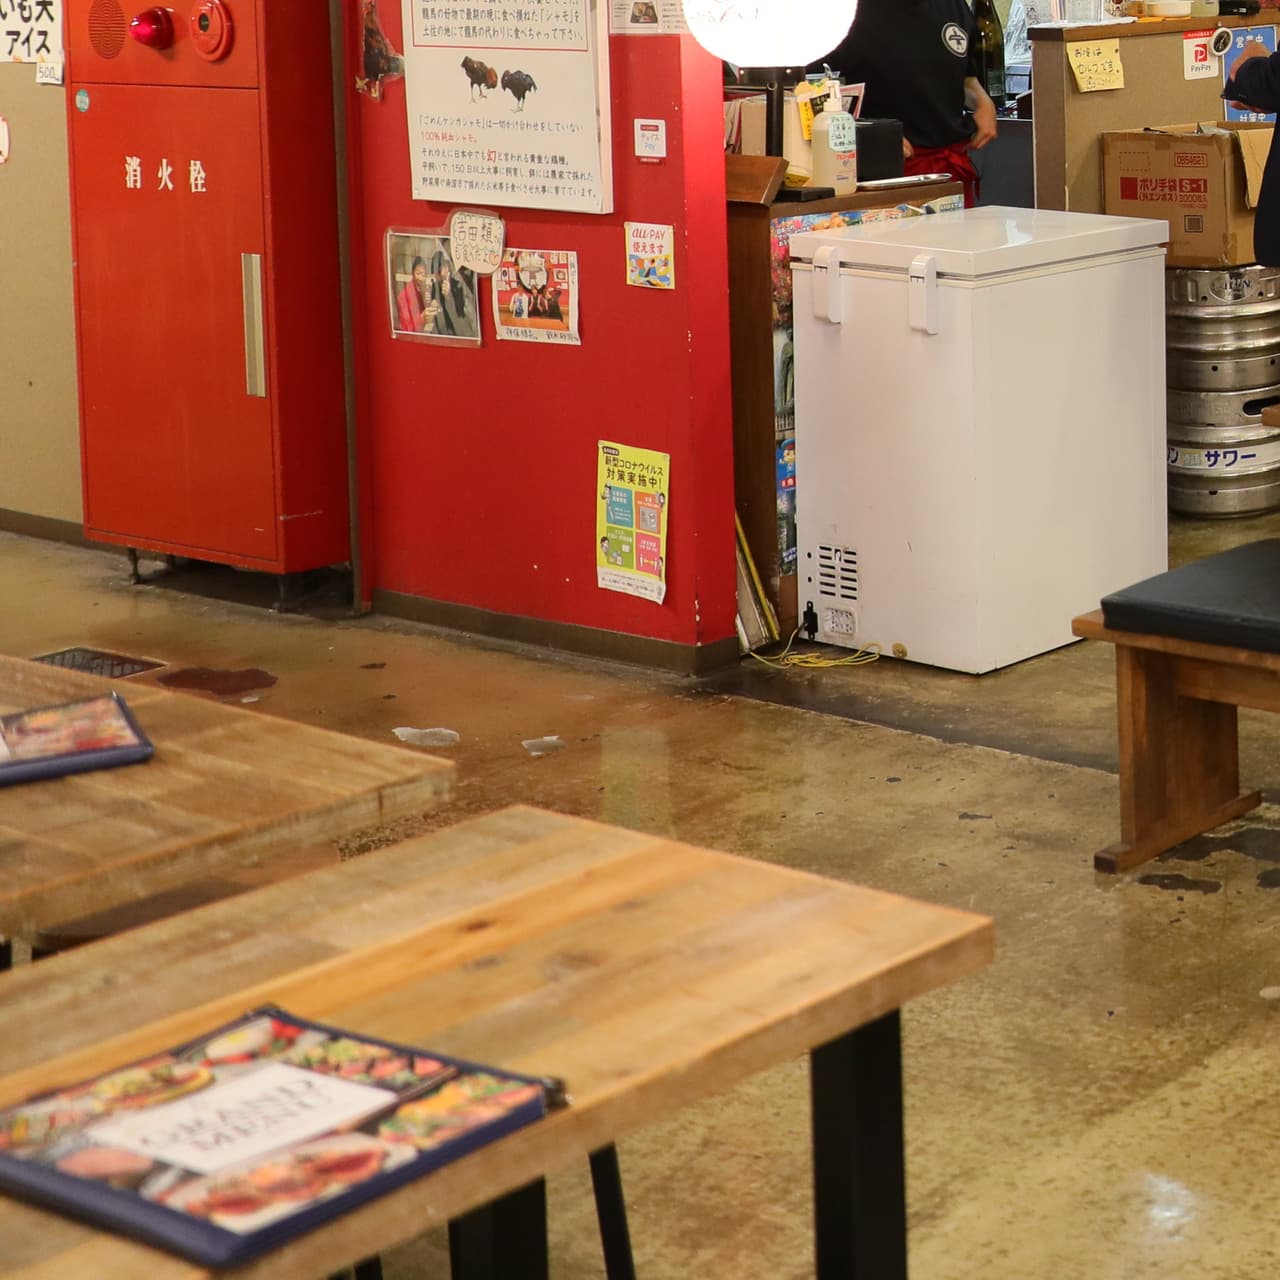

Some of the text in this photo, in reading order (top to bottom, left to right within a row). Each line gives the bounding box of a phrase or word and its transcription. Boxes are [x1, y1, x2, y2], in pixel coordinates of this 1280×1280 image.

[6, 28, 51, 58] アイス
[1191, 64, 1211, 72] PayPay
[125, 156, 207, 193] 消火栓
[1138, 178, 1205, 191] ポリ手袋 S-1
[650, 229, 666, 240] PAY
[632, 243, 664, 254] 使えます
[605, 456, 663, 476] 新型コロナウイルス
[1204, 448, 1257, 469] サワー
[606, 468, 662, 489] 対策実施中!
